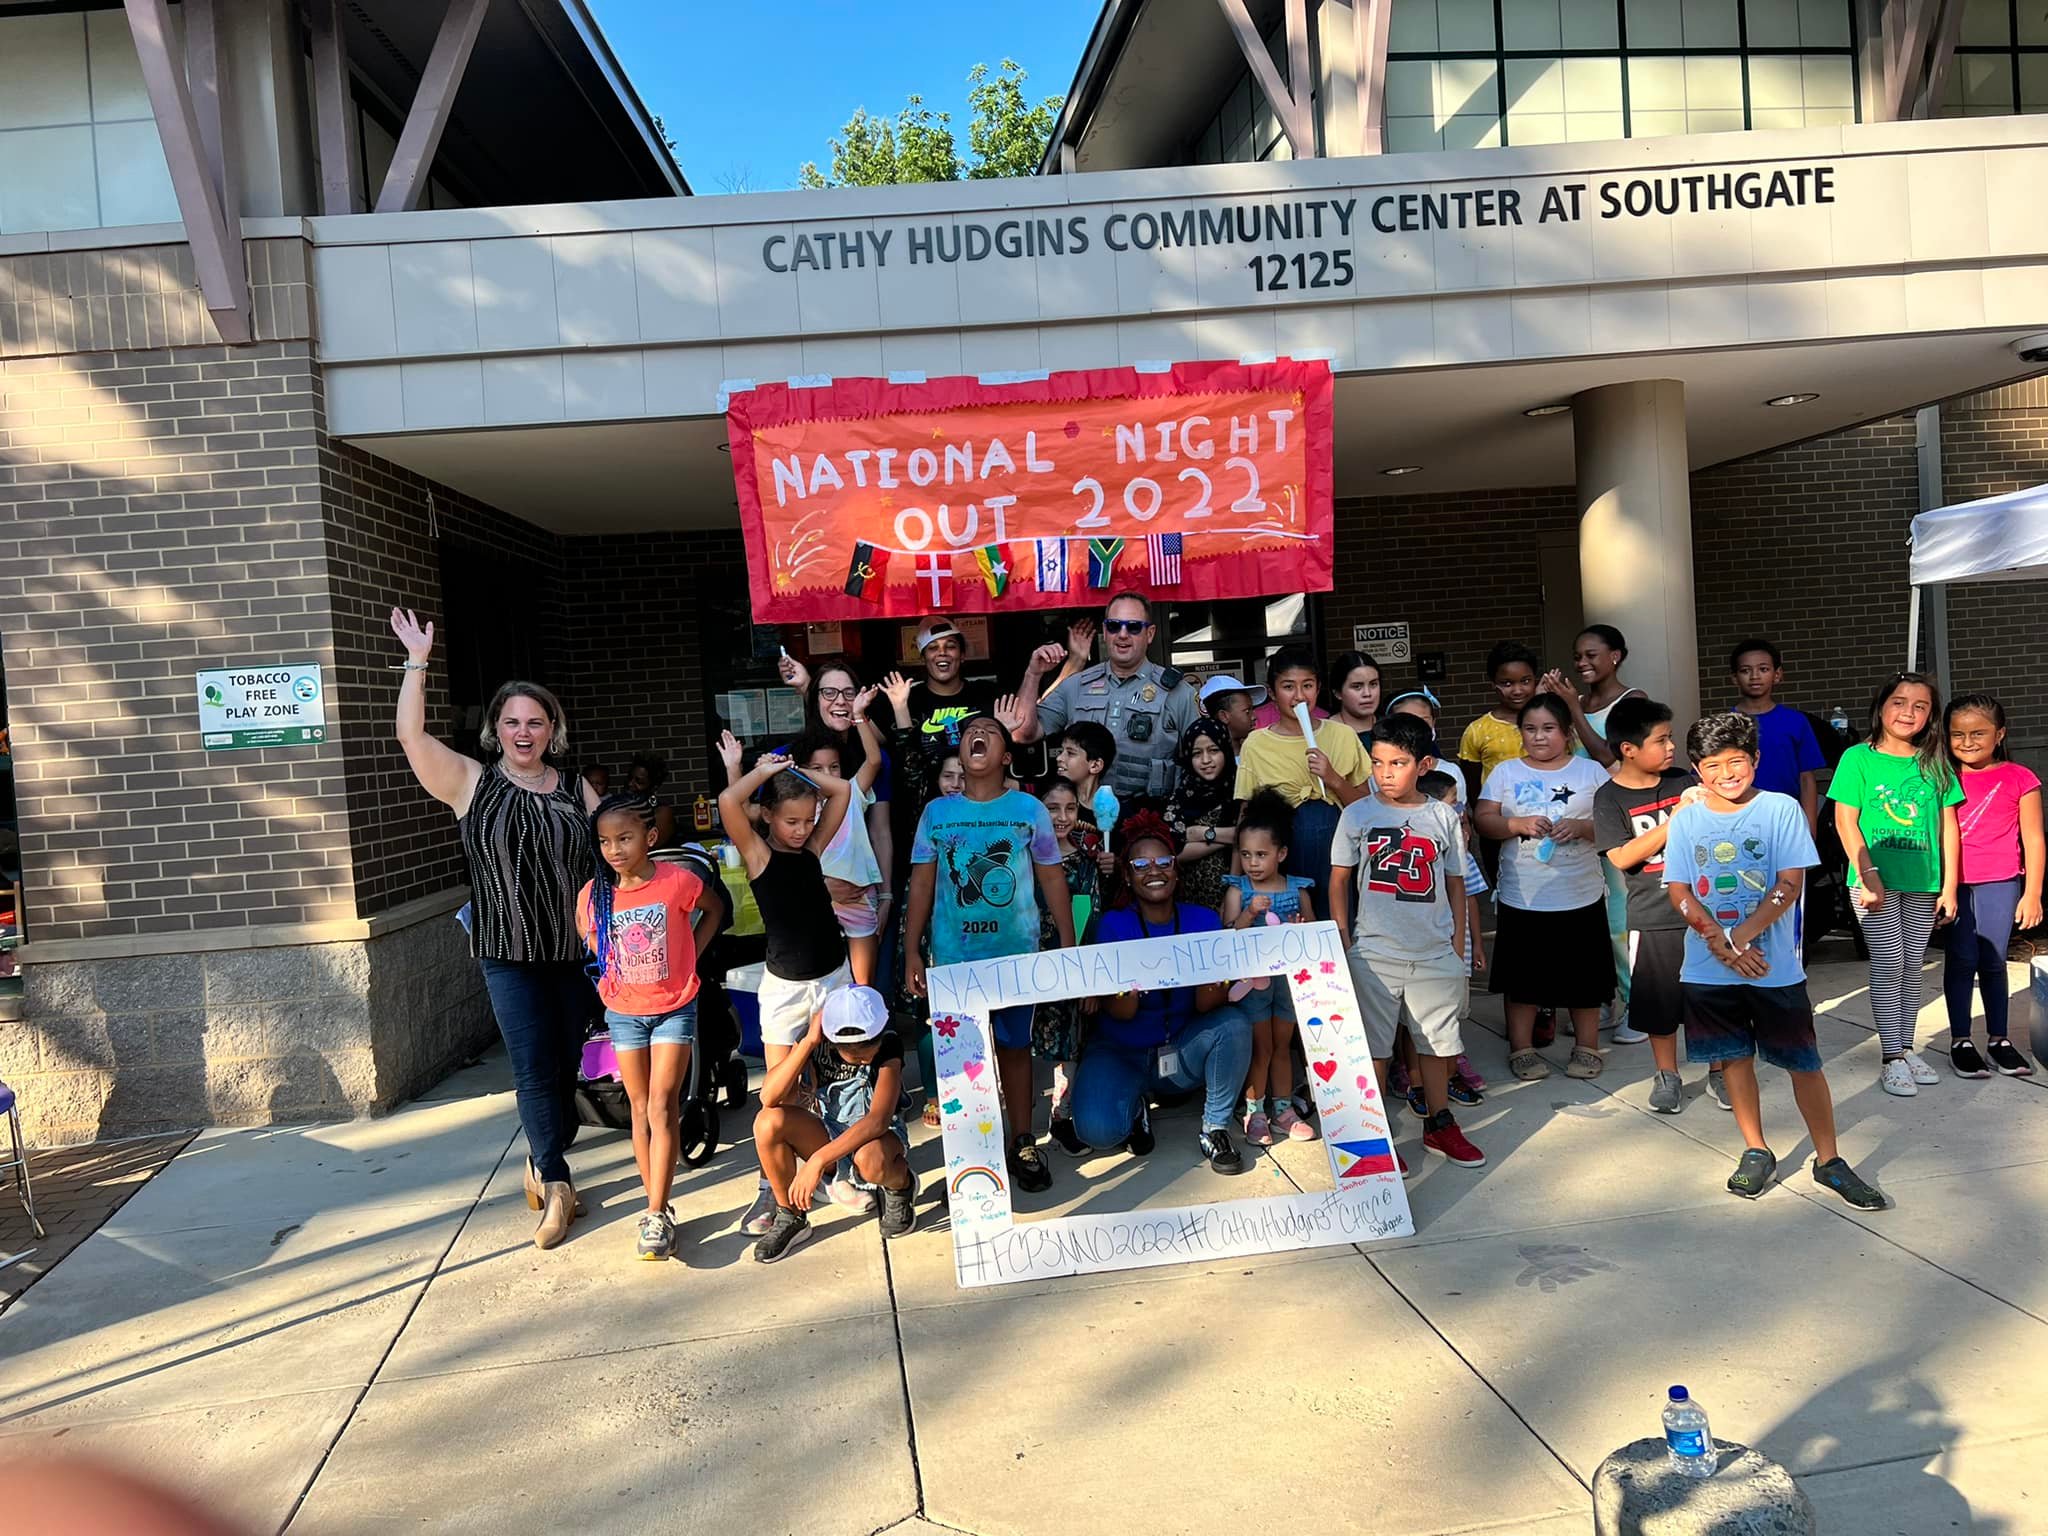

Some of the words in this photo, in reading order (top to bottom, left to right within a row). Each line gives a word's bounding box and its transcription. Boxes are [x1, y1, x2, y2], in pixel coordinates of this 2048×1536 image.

[762, 228, 893, 273] CATHY
[907, 216, 1089, 265] HUDGINS
[1103, 199, 1357, 252] COMMUNITY
[1370, 188, 1522, 234] CENTER
[1538, 183, 1587, 225] AT
[1599, 166, 1836, 220] SOUTHGATE
[1247, 249, 1355, 292] 12125
[771, 430, 1056, 508] NATIONAL
[1114, 409, 1296, 464] NIGHT
[893, 493, 1018, 551] OUT
[1072, 457, 1267, 529] 2022
[1358, 626, 1406, 640] NOTICE
[228, 672, 291, 687] TOBACCO
[246, 689, 277, 701] FREE
[226, 706, 257, 719] PLAY
[264, 704, 300, 717] ZONE
[930, 706, 969, 724] NIKE
[1367, 827, 1440, 903] 23
[611, 908, 664, 931] SPREAD
[962, 920, 998, 934] 2020
[931, 948, 1137, 1011] NATIONAL
[1173, 933, 1264, 976] NIGHT
[1282, 927, 1337, 964] OUT
